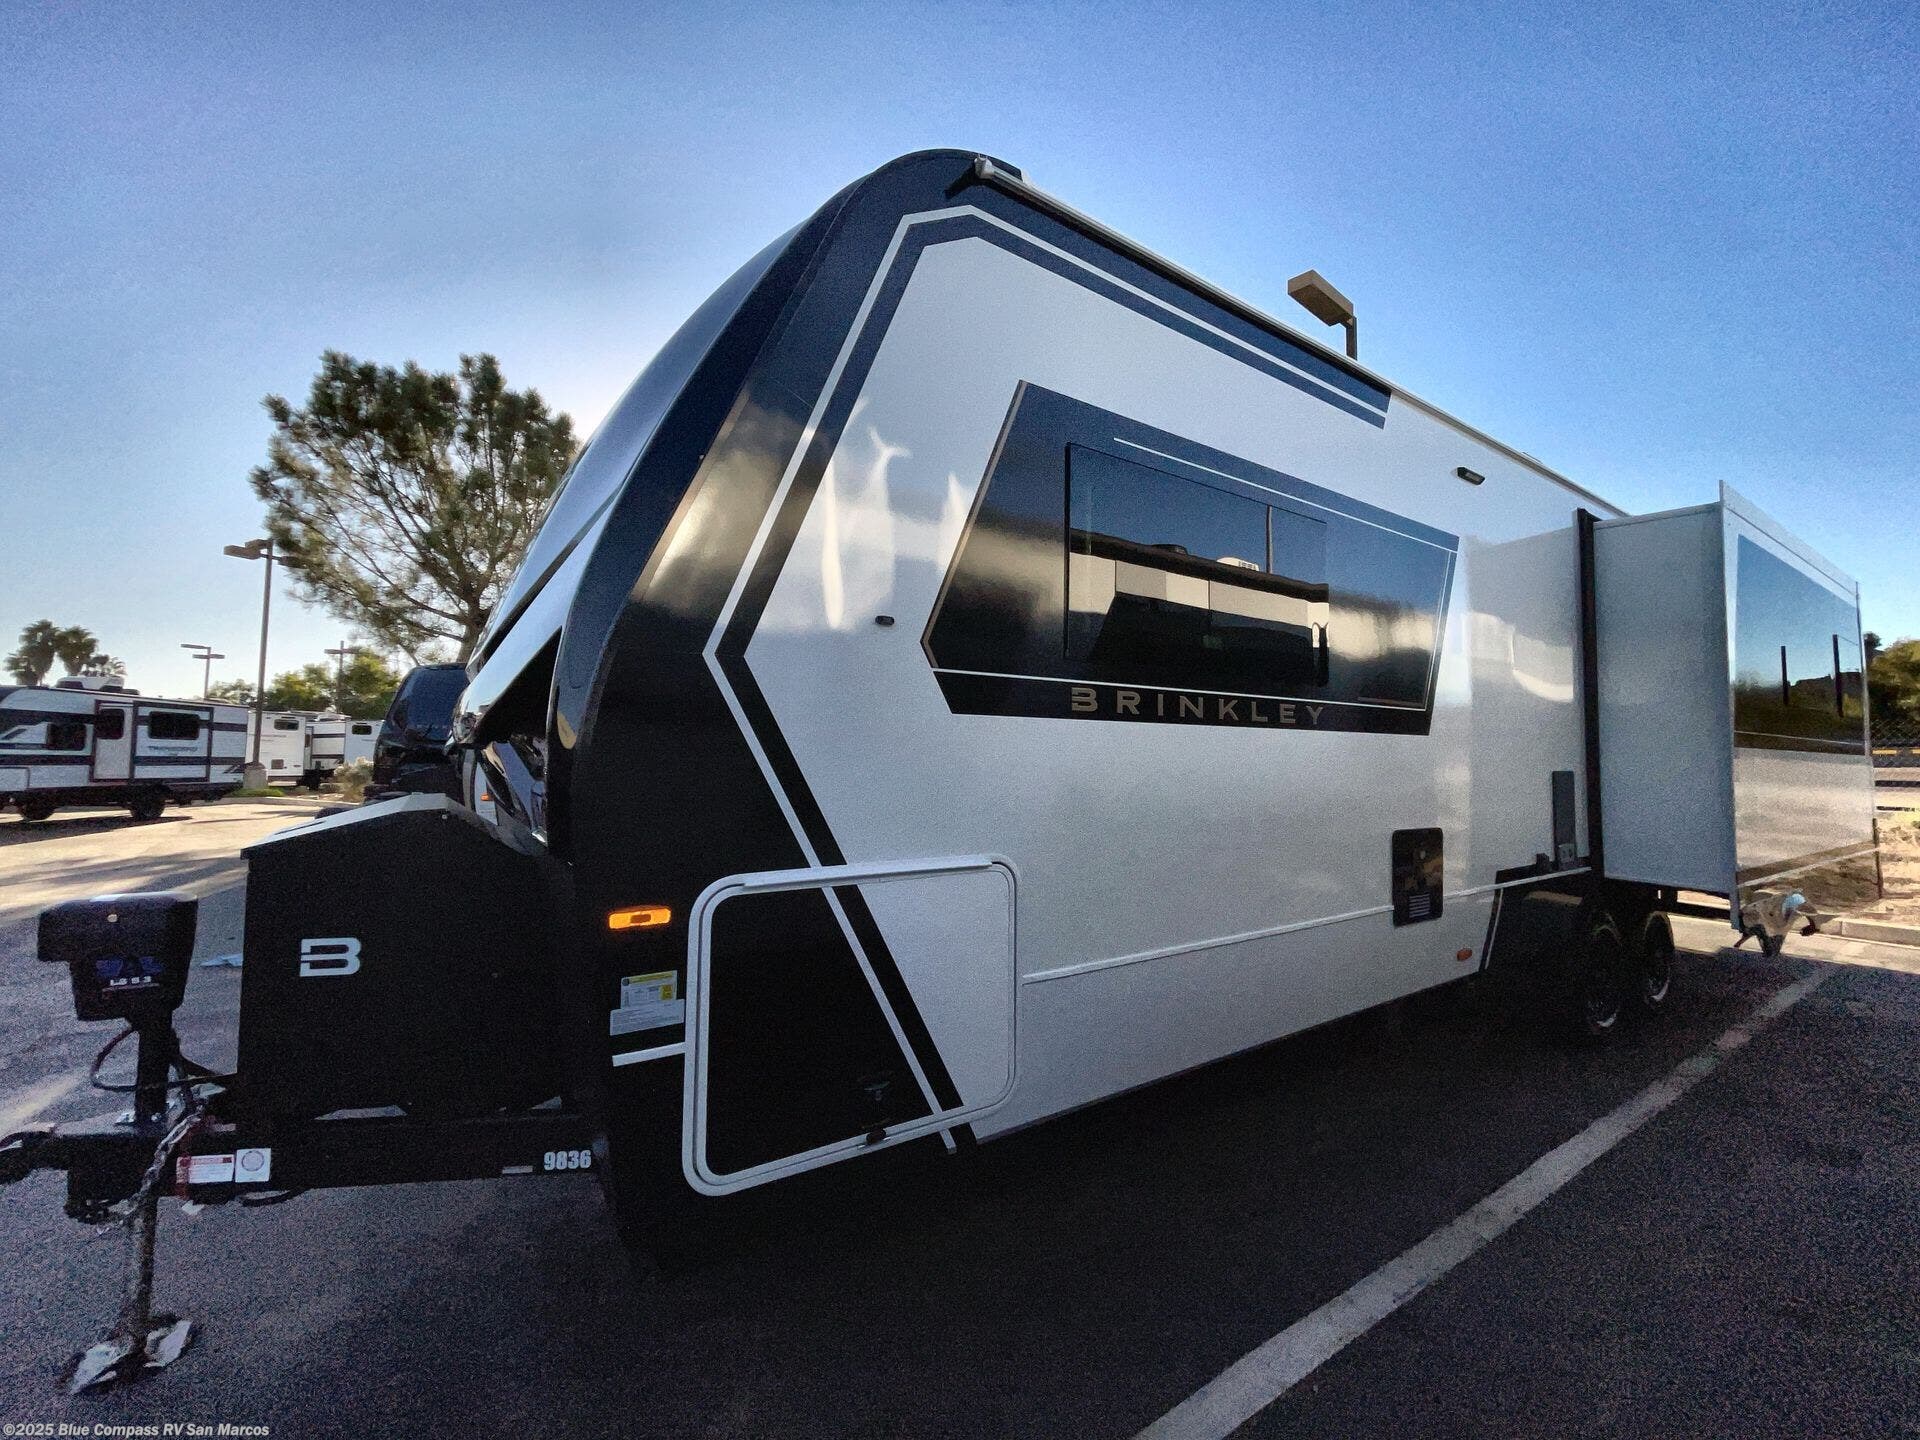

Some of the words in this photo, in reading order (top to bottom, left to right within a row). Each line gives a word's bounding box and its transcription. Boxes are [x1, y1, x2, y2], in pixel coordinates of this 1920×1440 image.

[1071, 687, 1324, 725] BRINKLEY
[300, 937, 361, 977] B
[543, 1149, 592, 1171] 9836
